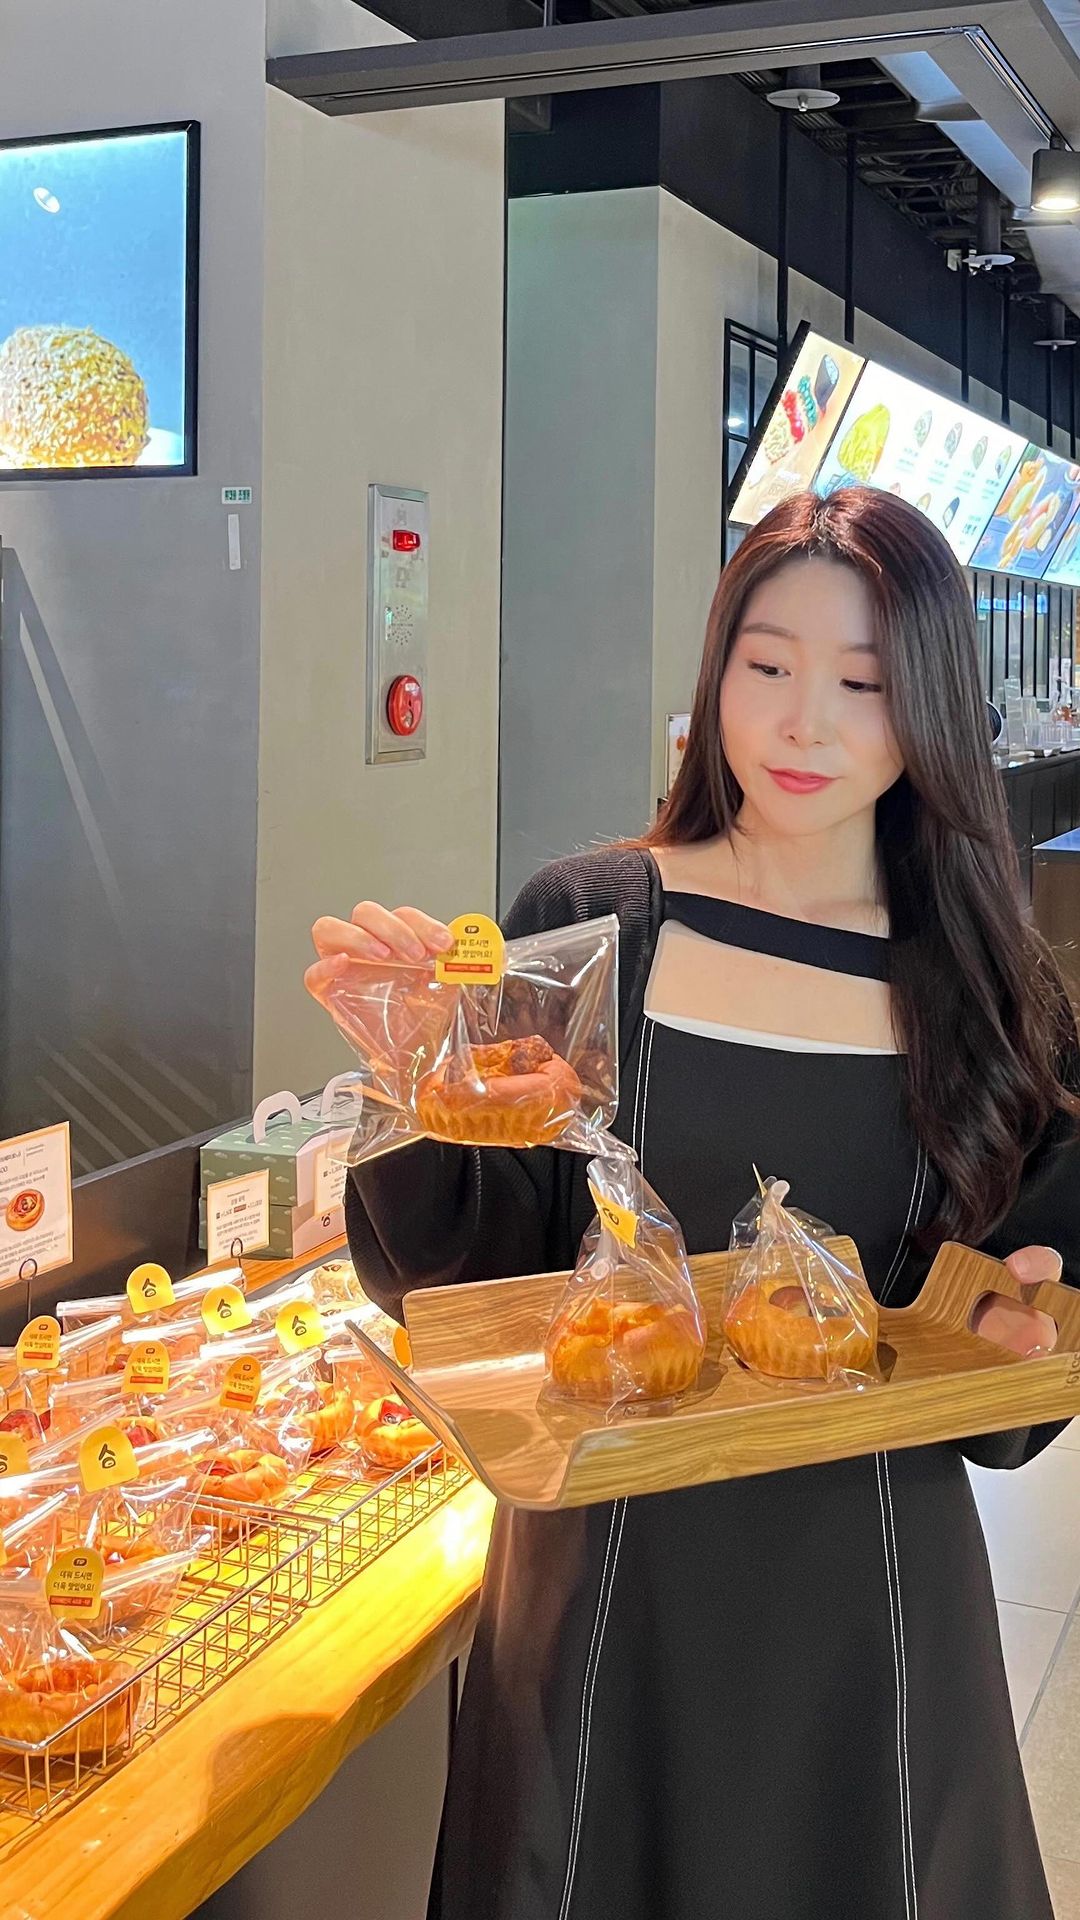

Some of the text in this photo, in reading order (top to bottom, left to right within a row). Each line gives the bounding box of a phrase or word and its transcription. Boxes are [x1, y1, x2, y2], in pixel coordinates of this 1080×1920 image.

[60, 1570, 93, 1580] 데워 드시면
[53, 1581, 95, 1592] 더욱 맛있어요!
